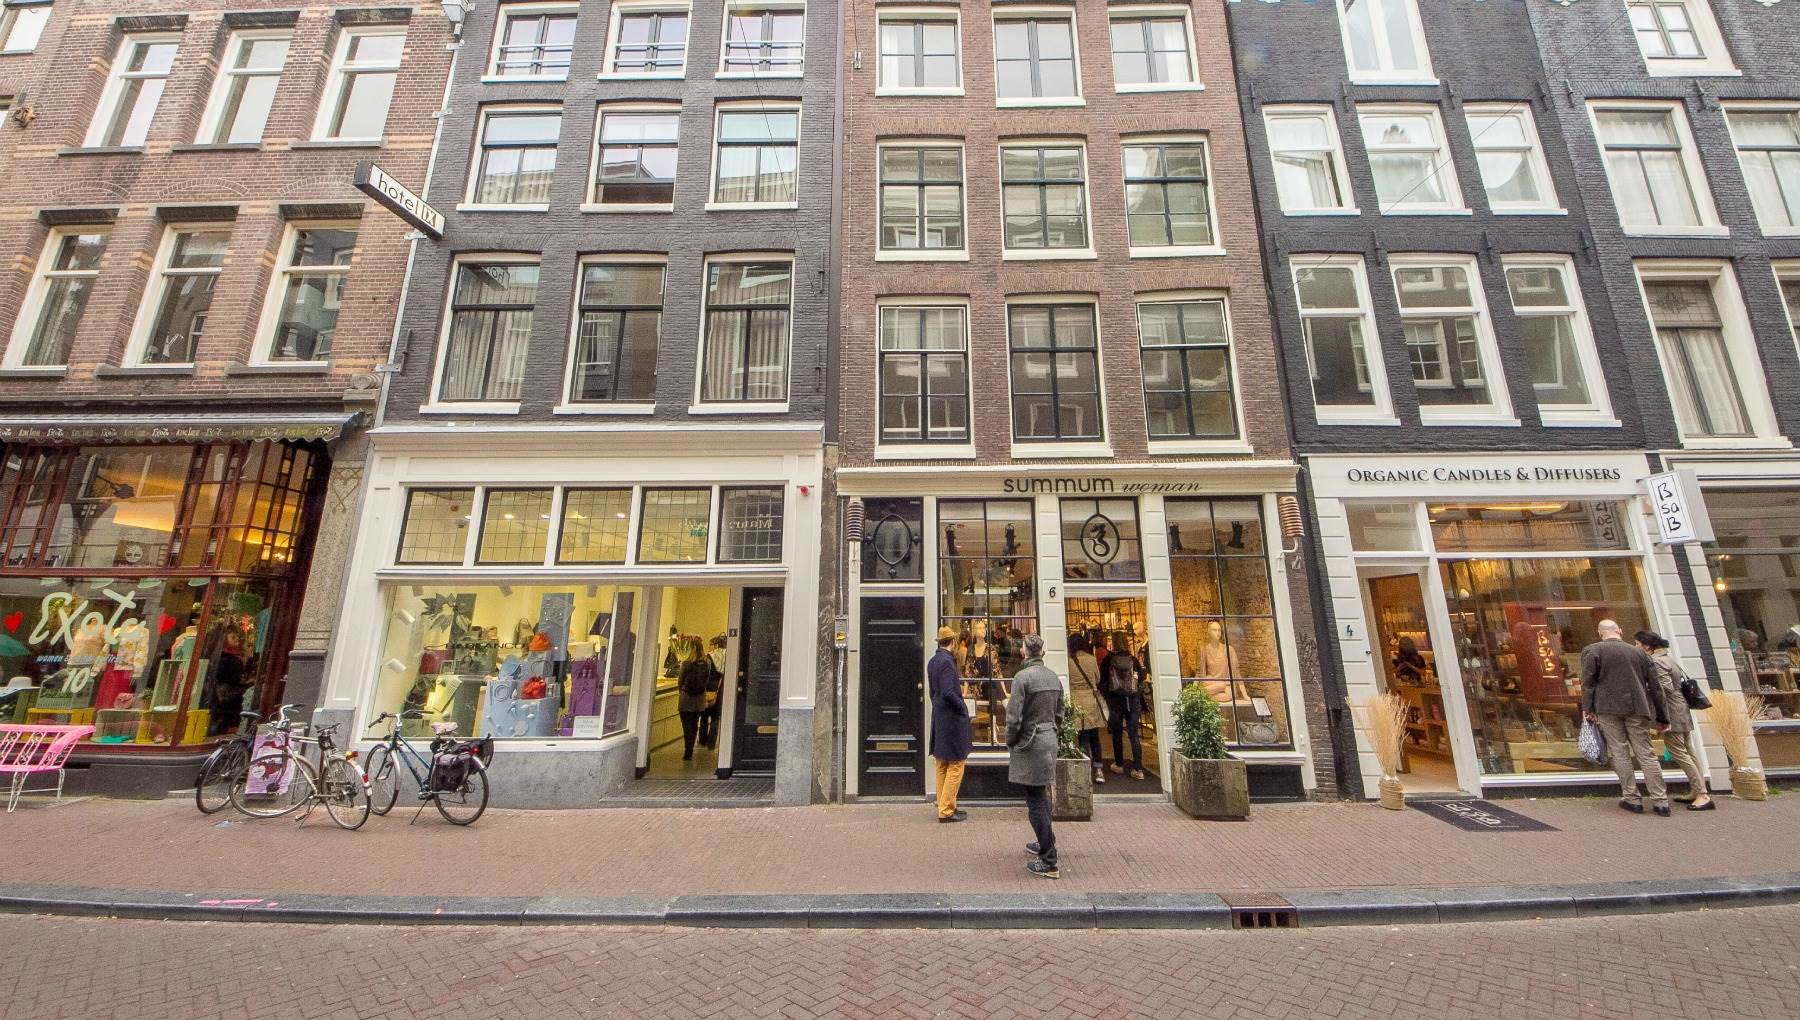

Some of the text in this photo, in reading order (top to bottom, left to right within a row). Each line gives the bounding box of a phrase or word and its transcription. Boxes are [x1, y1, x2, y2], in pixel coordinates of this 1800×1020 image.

[378, 172, 419, 215] hotel
[1347, 467, 1621, 482] ORGANIC CANDLES & DIFFUSERS
[1003, 477, 1200, 493] summum woman
[1049, 586, 1056, 598] 6
[1346, 624, 1354, 636] 4
[61, 668, 90, 693] 10
